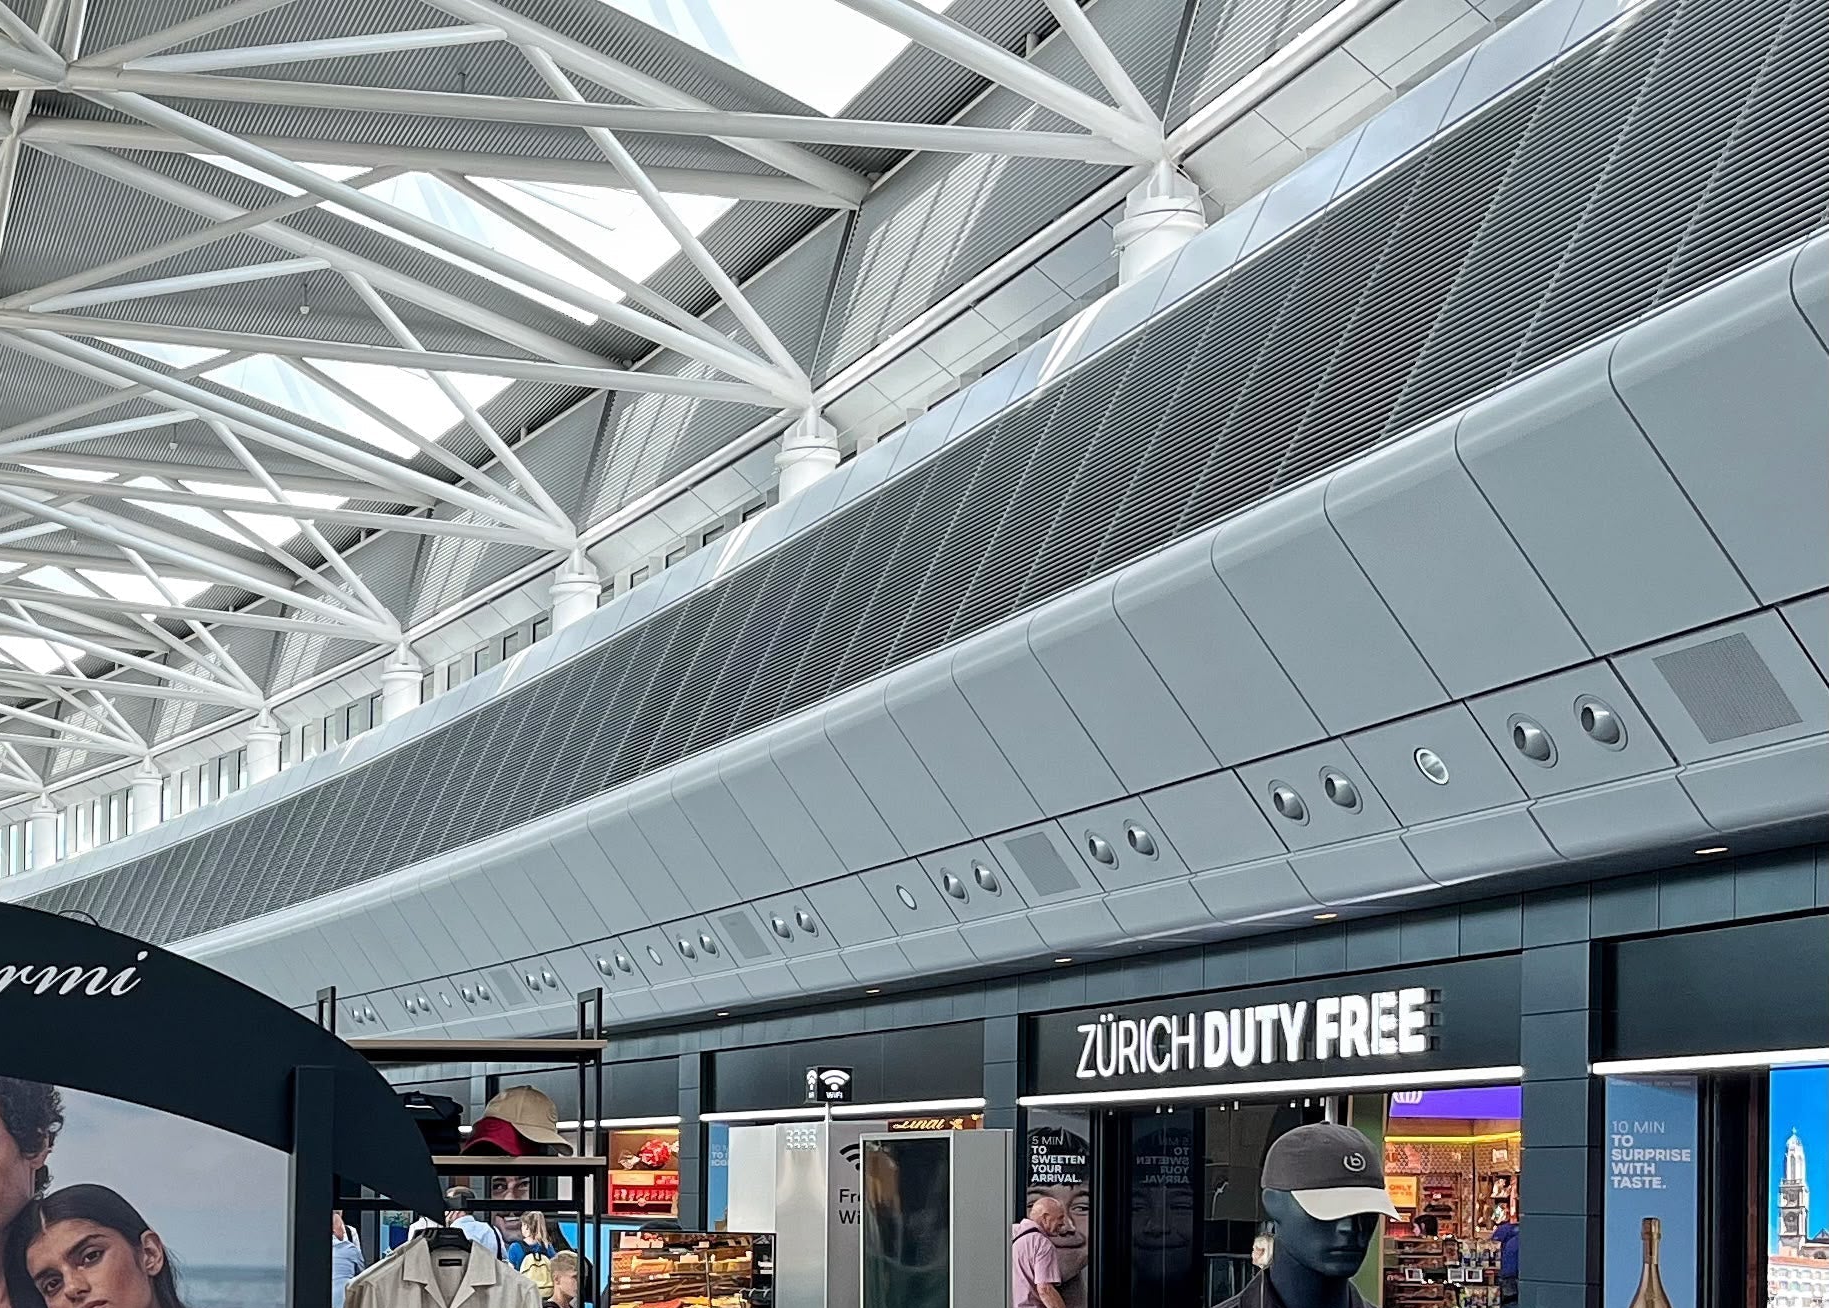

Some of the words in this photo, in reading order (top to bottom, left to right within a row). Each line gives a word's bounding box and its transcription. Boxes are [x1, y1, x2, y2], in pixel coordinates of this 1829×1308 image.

[1076, 1013, 1196, 1079] ZÜRICH
[1204, 1001, 1307, 1068] DUTY
[1316, 988, 1427, 1060] FREE
[1612, 1121, 1628, 1134] 10
[1634, 1121, 1665, 1134] MIN
[1032, 1136, 1039, 1144] 5
[1041, 1136, 1063, 1145] MIN
[1611, 1135, 1634, 1147] TO
[1031, 1146, 1047, 1154] TO
[1611, 1149, 1691, 1161] SURPRISE
[1031, 1155, 1085, 1164] SWEETEN
[1031, 1165, 1062, 1173] YOUR
[1612, 1163, 1656, 1174] WITH
[1031, 1174, 1082, 1182] ARRIVAL.
[1611, 1177, 1667, 1189] TASTE.
